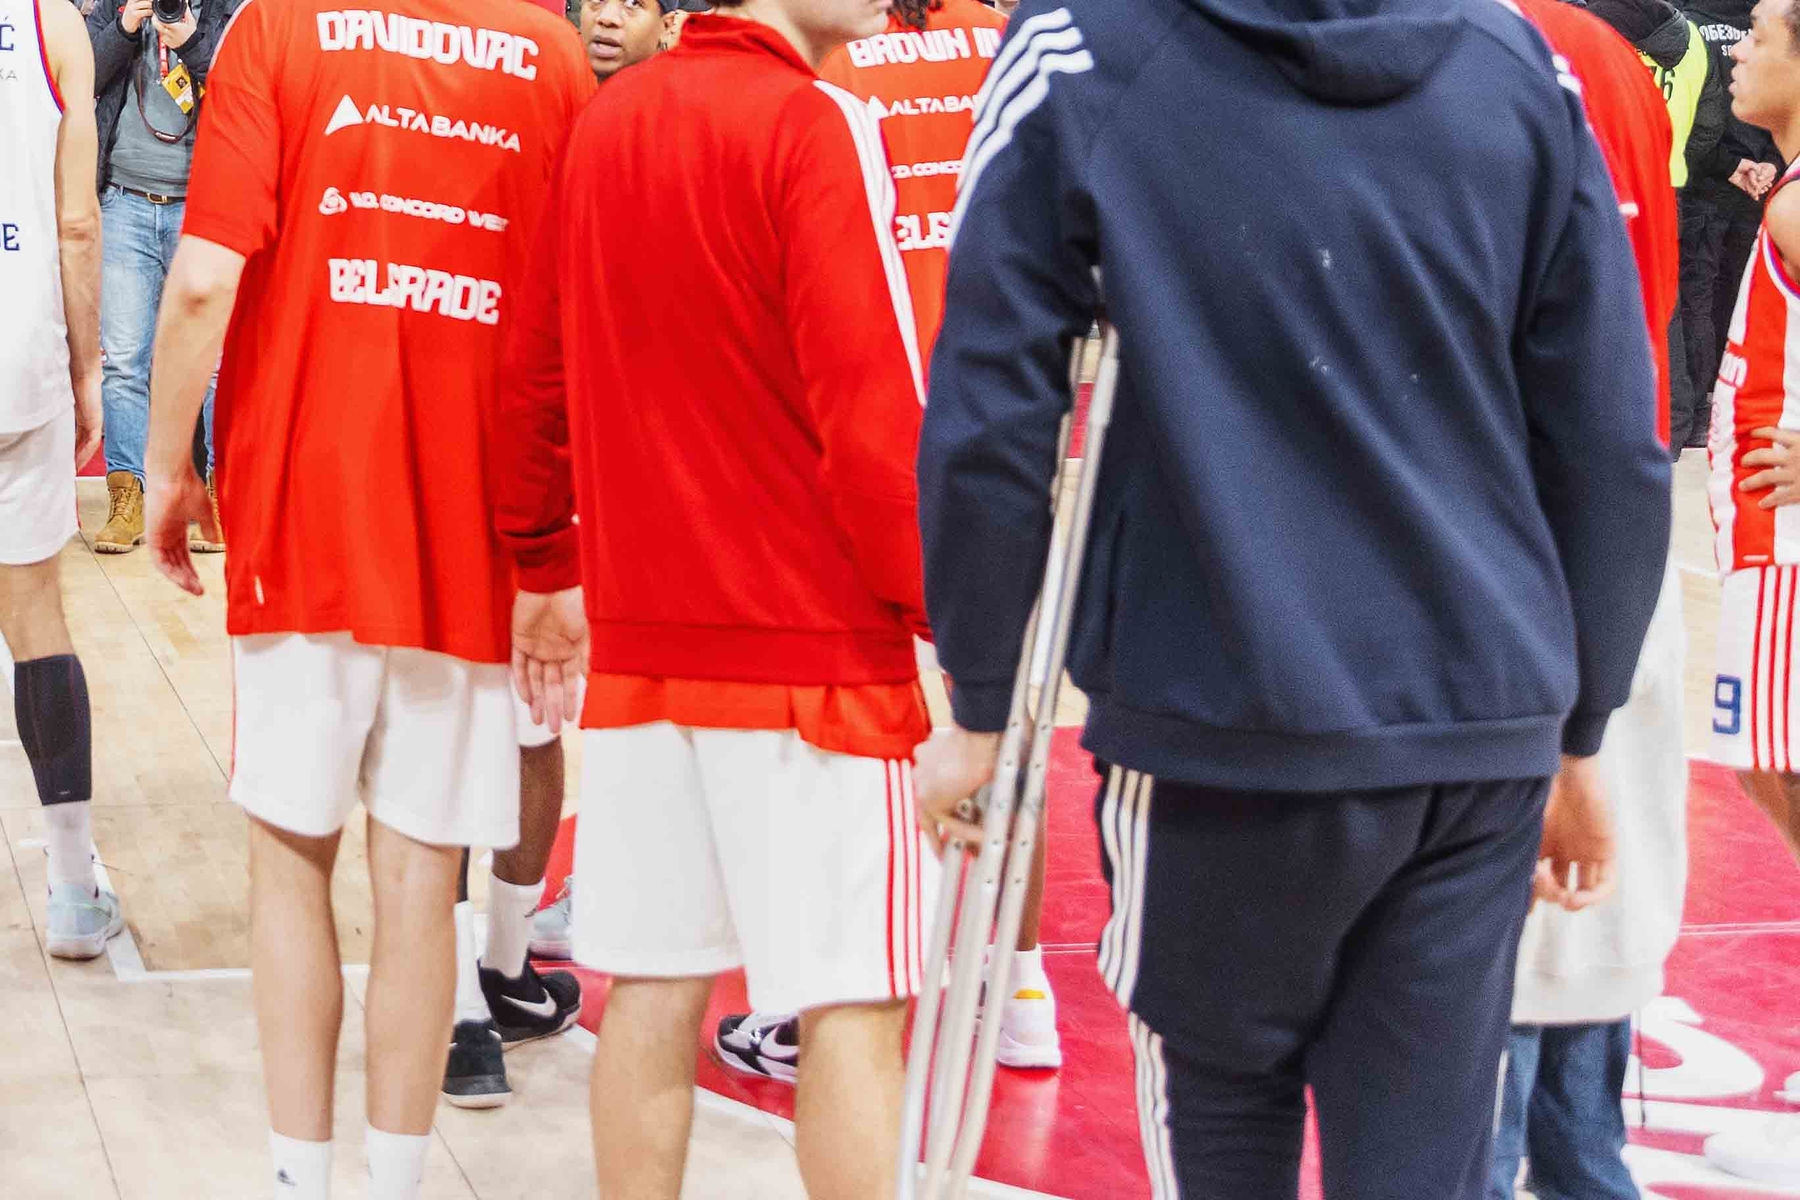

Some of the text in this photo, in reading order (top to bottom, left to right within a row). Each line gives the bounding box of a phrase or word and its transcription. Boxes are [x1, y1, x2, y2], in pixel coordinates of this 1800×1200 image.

[316, 8, 540, 81] DAVIDOVAC
[846, 27, 972, 68] BROWN
[364, 102, 522, 154] ALTABANKA
[1712, 673, 1743, 736] 9
